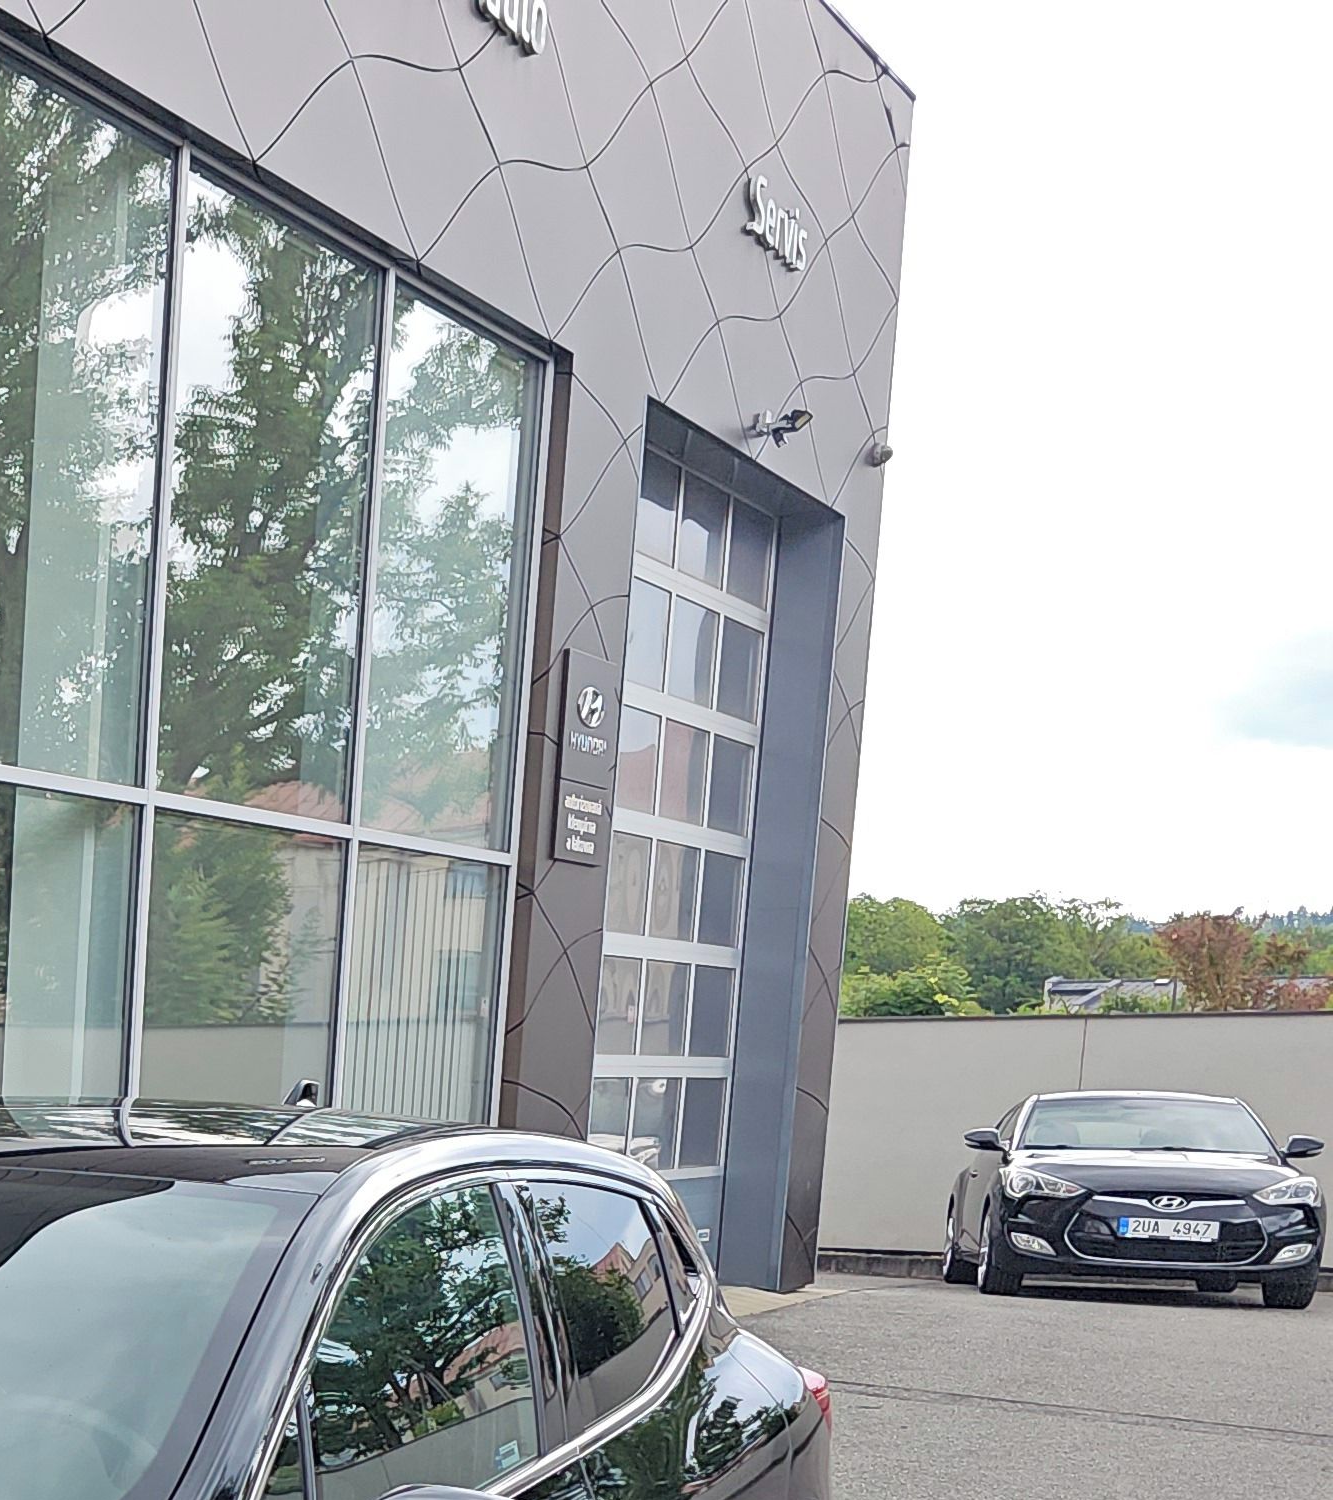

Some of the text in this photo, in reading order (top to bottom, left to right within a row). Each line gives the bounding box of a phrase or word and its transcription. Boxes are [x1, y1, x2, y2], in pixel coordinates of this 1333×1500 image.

[746, 175, 808, 272] Servis
[570, 730, 607, 756] HYUNDAI
[1132, 1220, 1211, 1236] 2UA 4947
